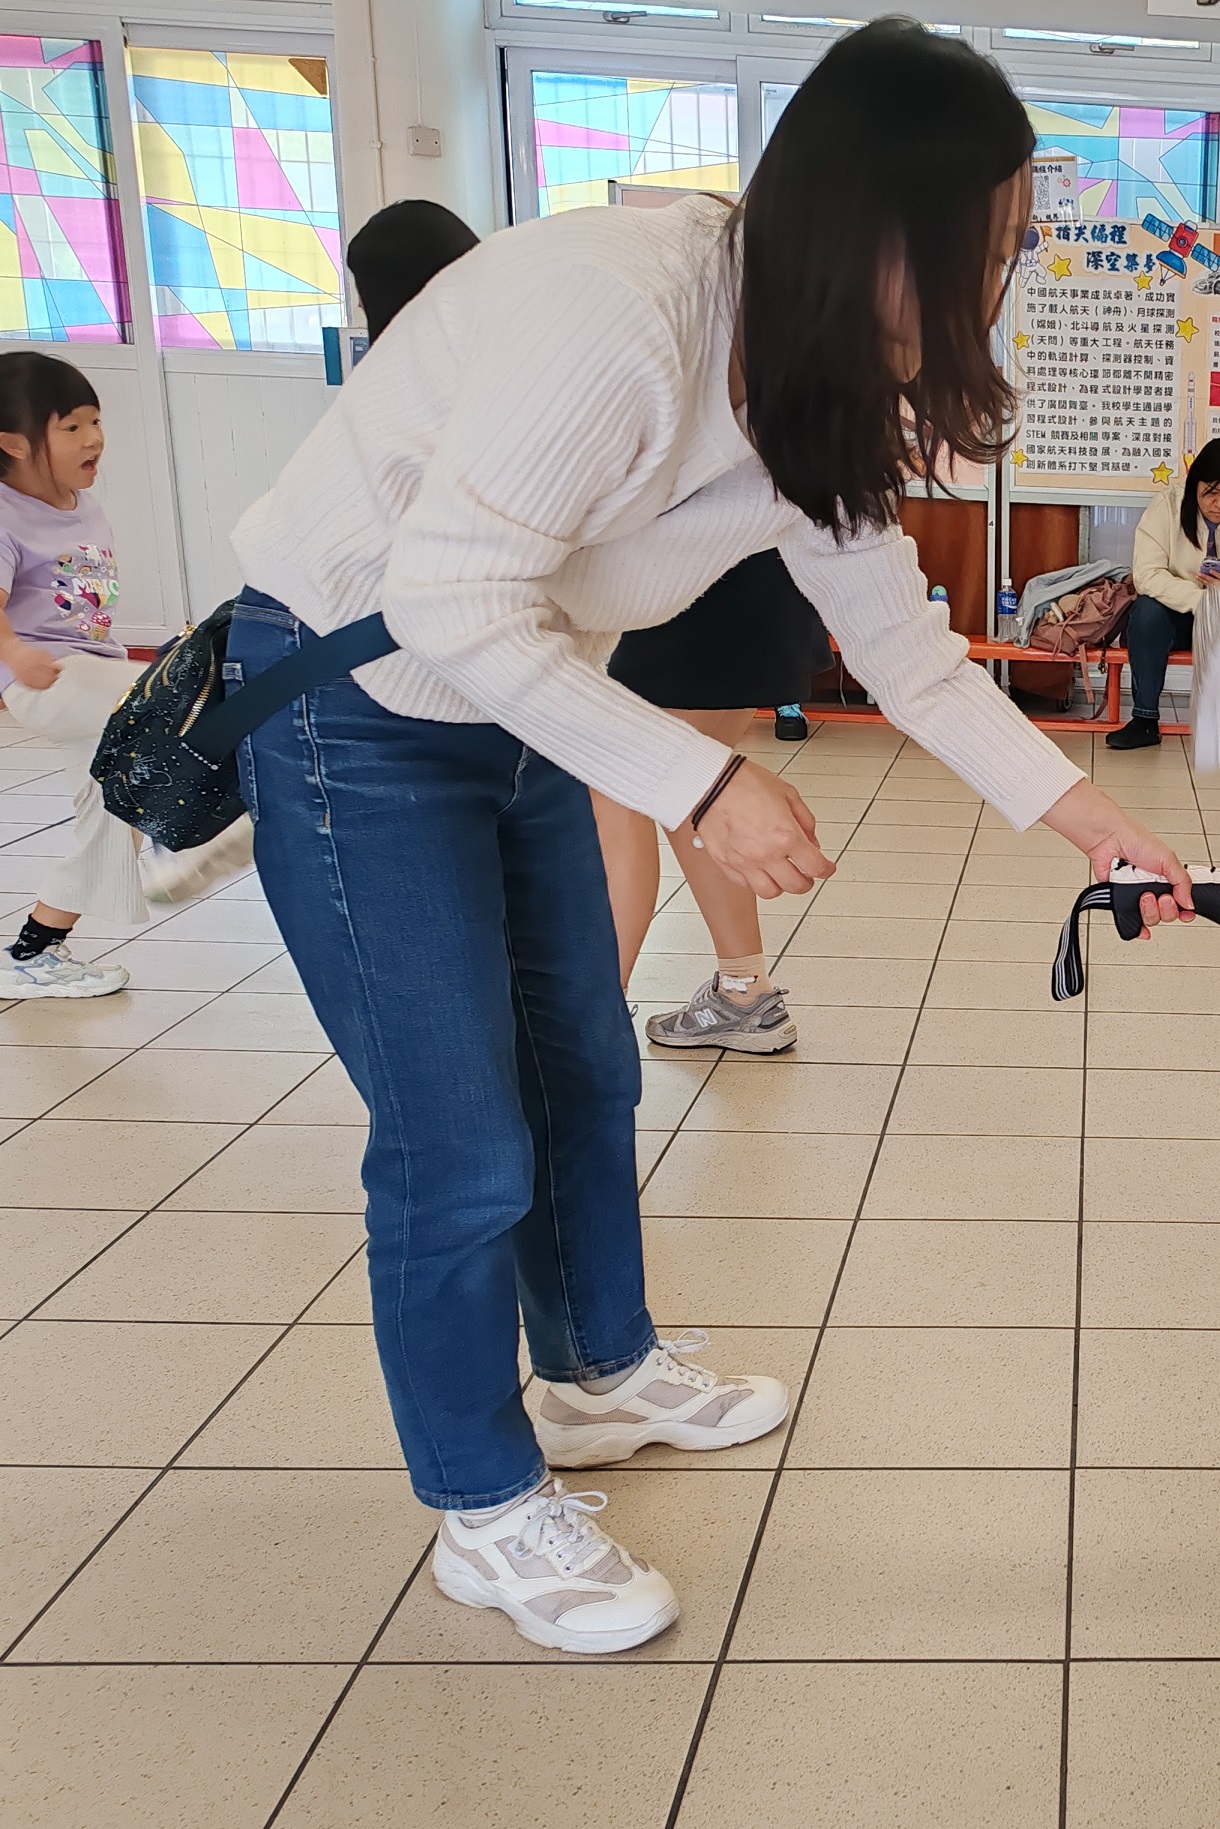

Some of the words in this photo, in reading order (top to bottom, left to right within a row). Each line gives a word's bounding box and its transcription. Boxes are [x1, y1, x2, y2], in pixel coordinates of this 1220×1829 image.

[1026, 430, 1046, 439] STEM
[72, 577, 119, 597] MAGIC
[694, 1008, 718, 1028] N
